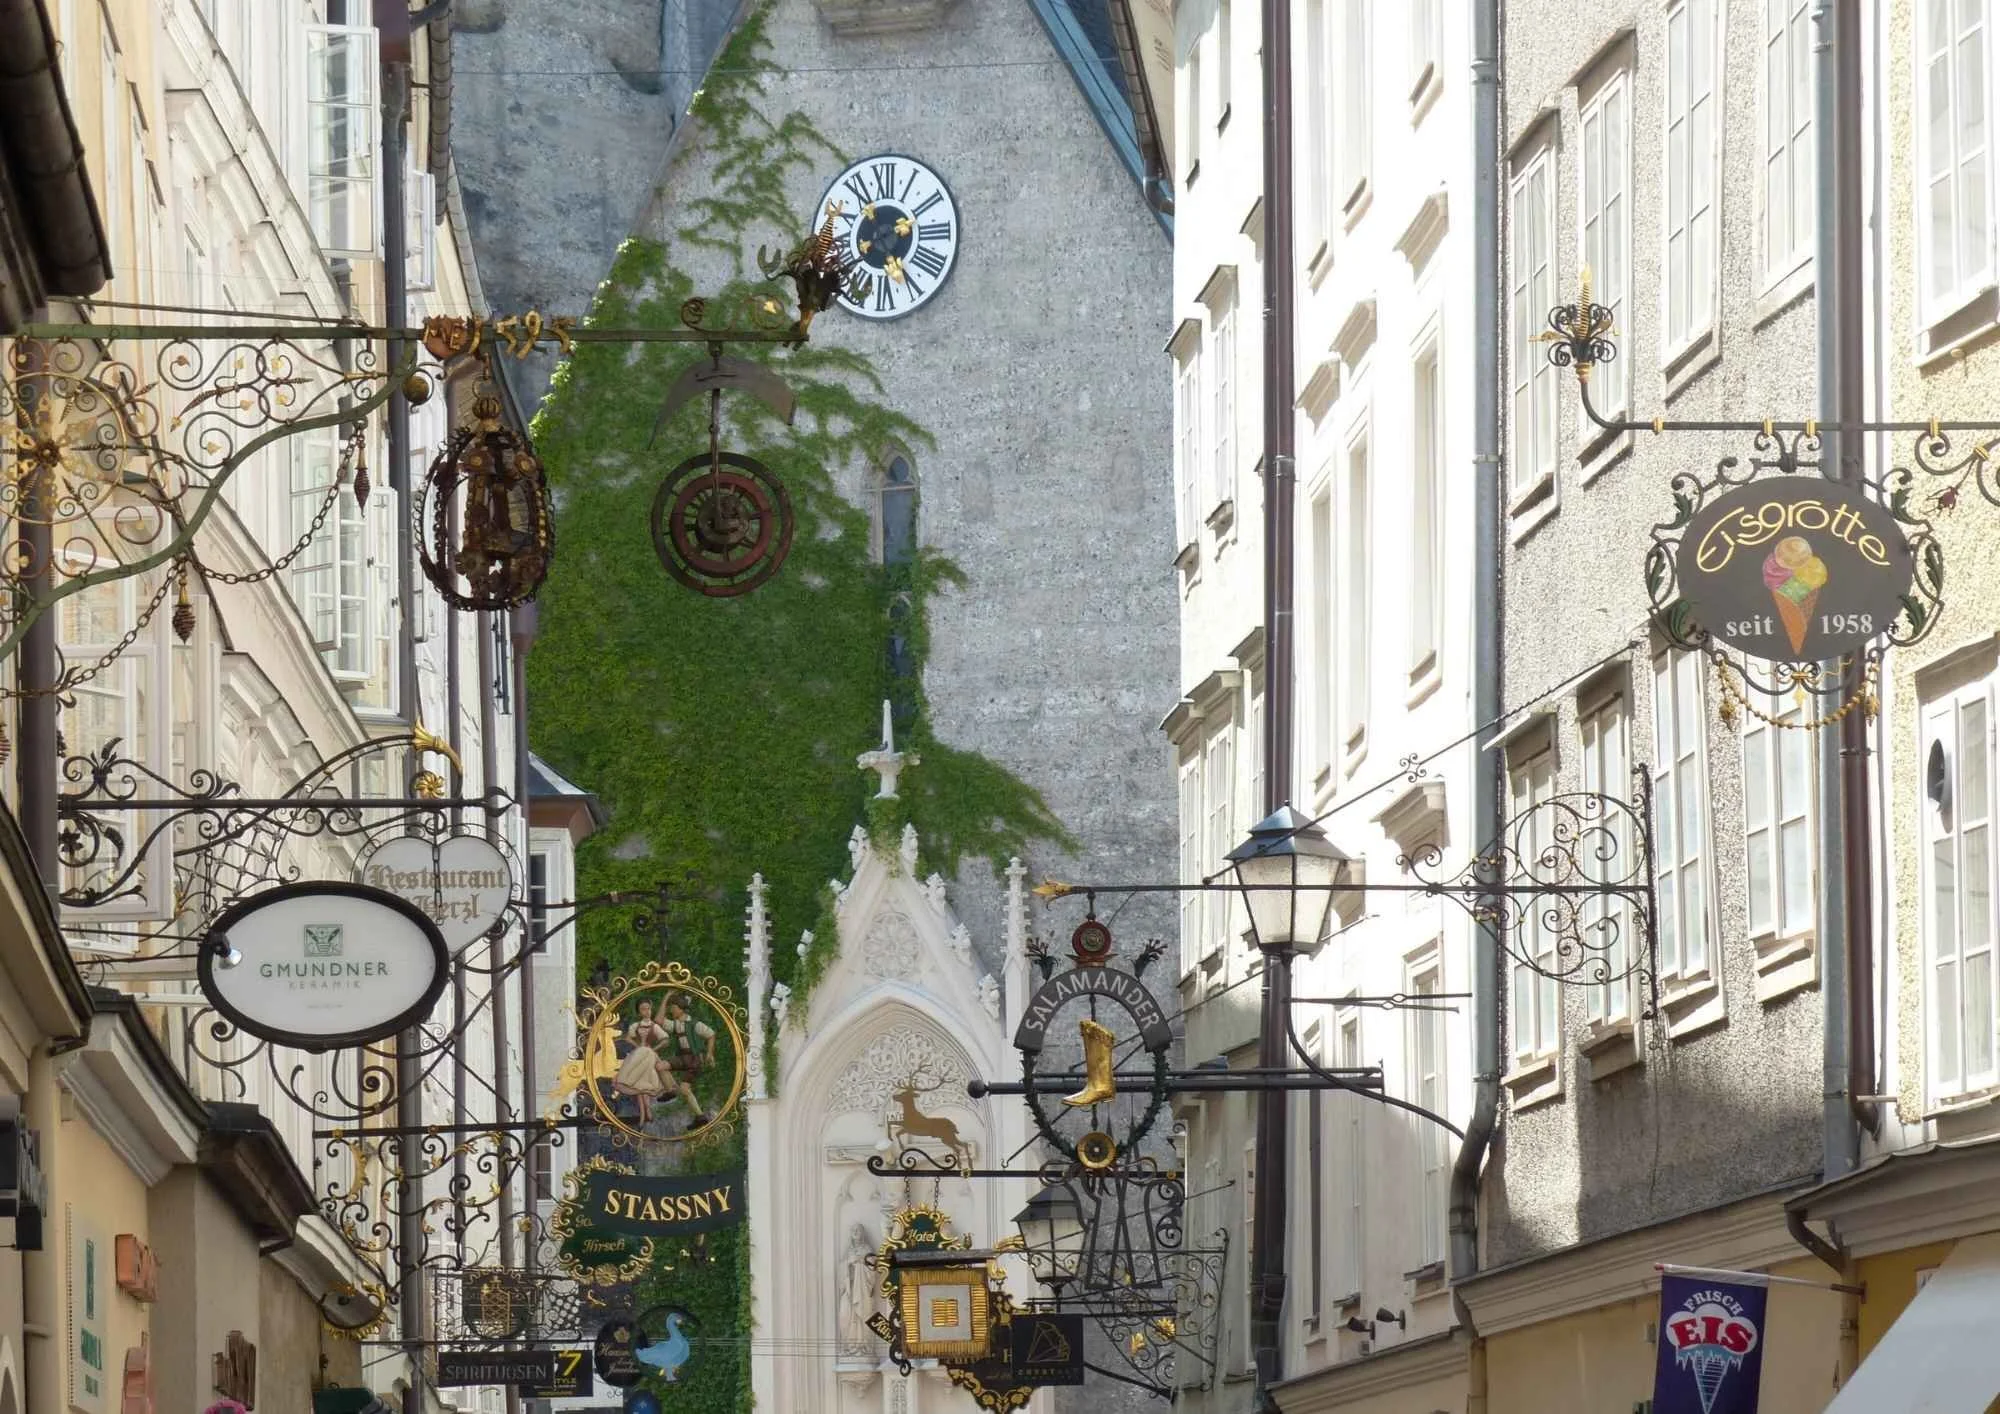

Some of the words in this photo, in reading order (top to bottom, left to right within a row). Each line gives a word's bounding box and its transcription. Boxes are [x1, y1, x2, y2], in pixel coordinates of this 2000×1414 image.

[1697, 500, 1891, 572] Eisgrotte
[1726, 615, 1774, 637] seit
[1820, 614, 1873, 635] 1958
[260, 962, 389, 978] GMUNDNER
[288, 980, 362, 990] KERAMIK
[1026, 971, 1160, 1032] SALAMANDER
[604, 1185, 731, 1222] STASSNY
[905, 1229, 938, 1243] Hotel
[1683, 1290, 1744, 1316] FRISCH
[1670, 1316, 1753, 1353] EIS
[446, 1365, 547, 1381] SPIRITUOSEN
